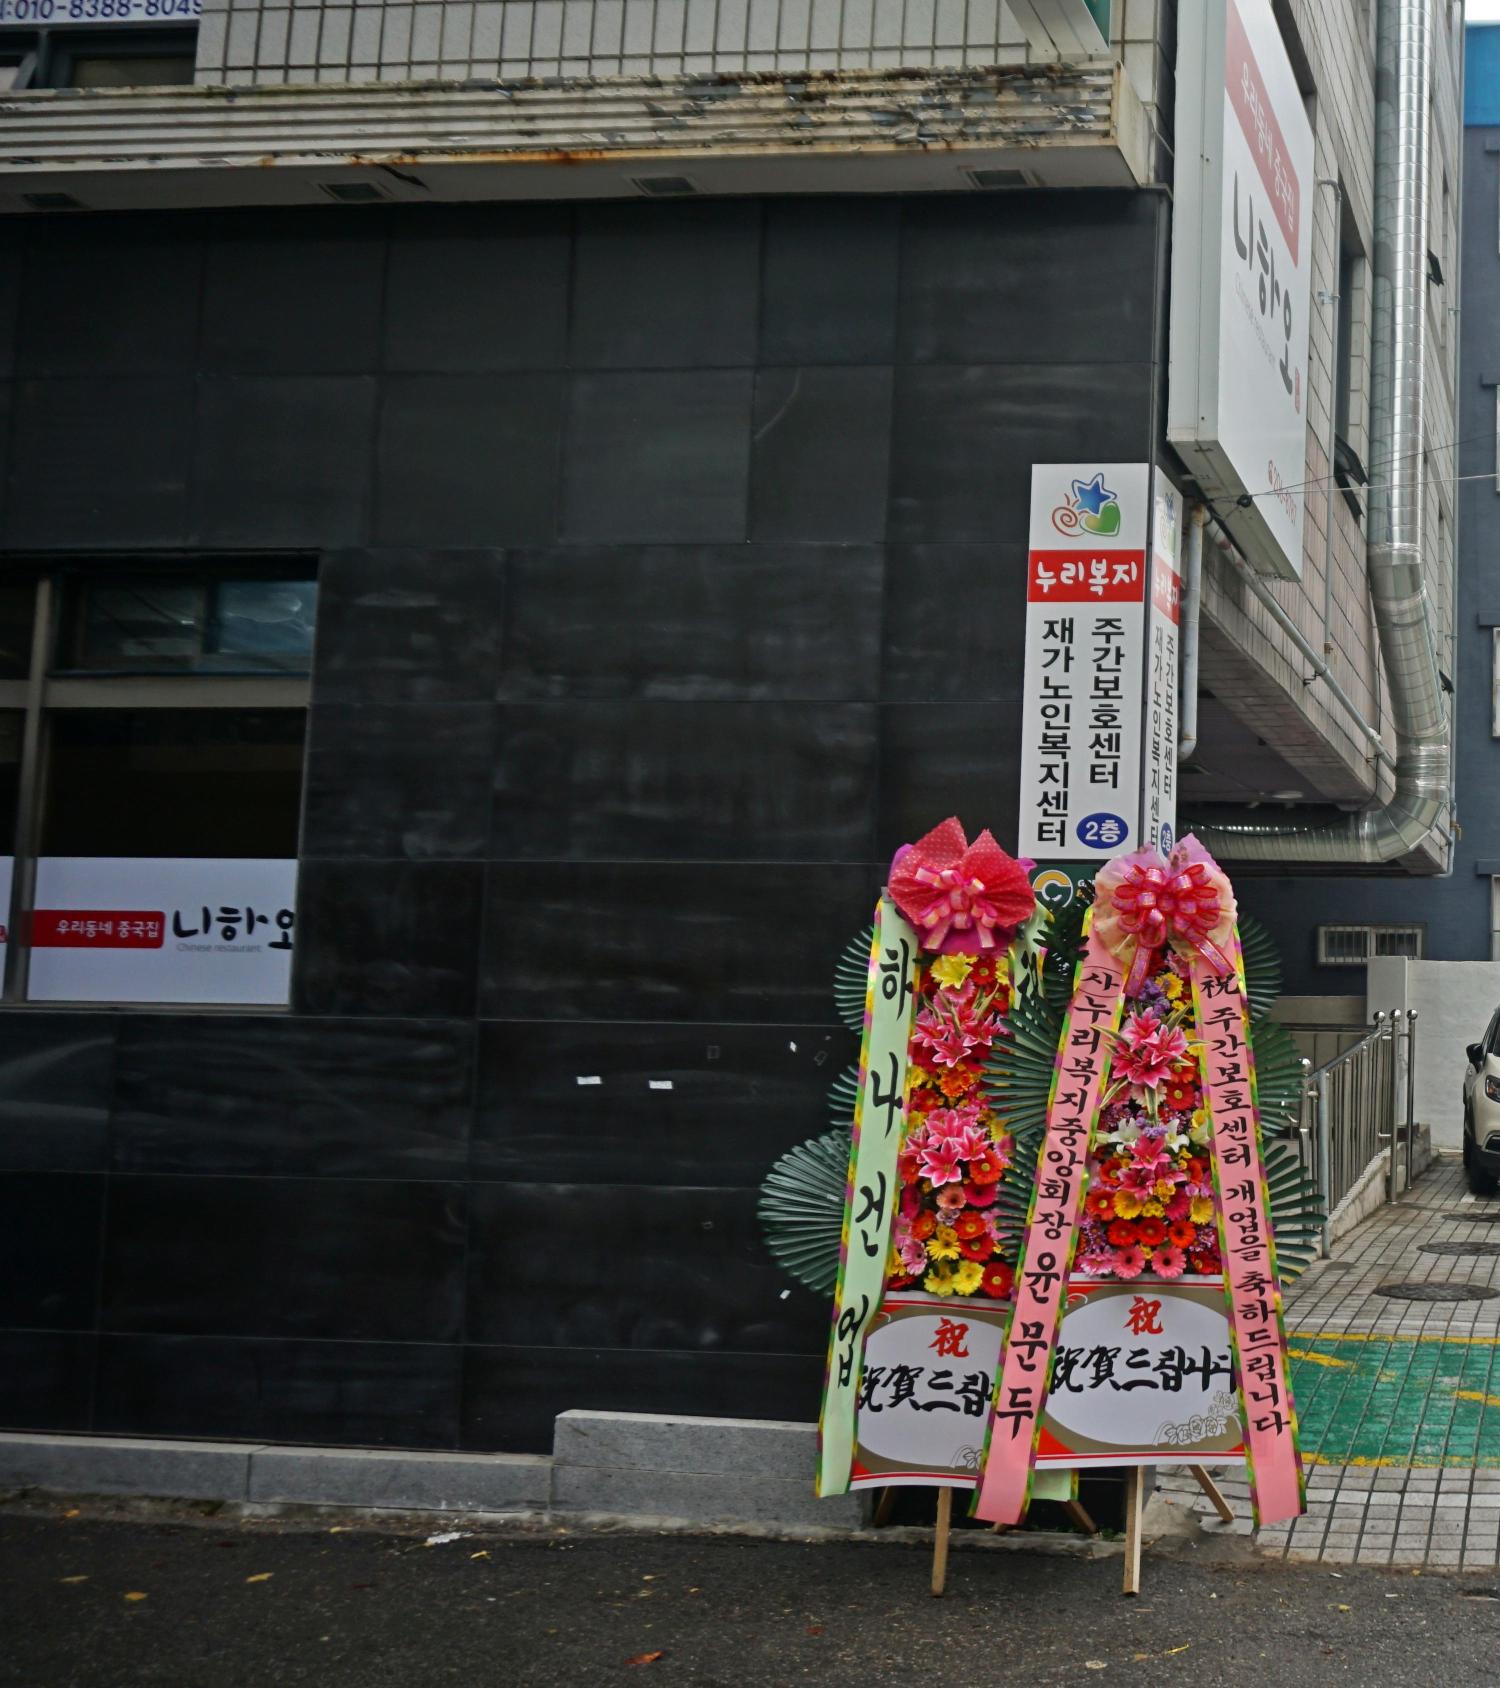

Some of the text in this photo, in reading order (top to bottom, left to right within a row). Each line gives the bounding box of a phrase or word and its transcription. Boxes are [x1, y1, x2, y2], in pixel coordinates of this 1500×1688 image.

[1035, 558, 1138, 596] 누리복지
[1088, 617, 1125, 789] 주간보호센터
[1036, 617, 1075, 848] 재가노인복지센터
[1085, 818, 1121, 843] 2층
[56, 906, 295, 950] 우리동네 중국집 니하오
[1200, 972, 1292, 1436] 祝 주간보호센터 개업을 축하드립니다
[1123, 1295, 1164, 1336] 祝
[928, 1317, 970, 1358] 祝
